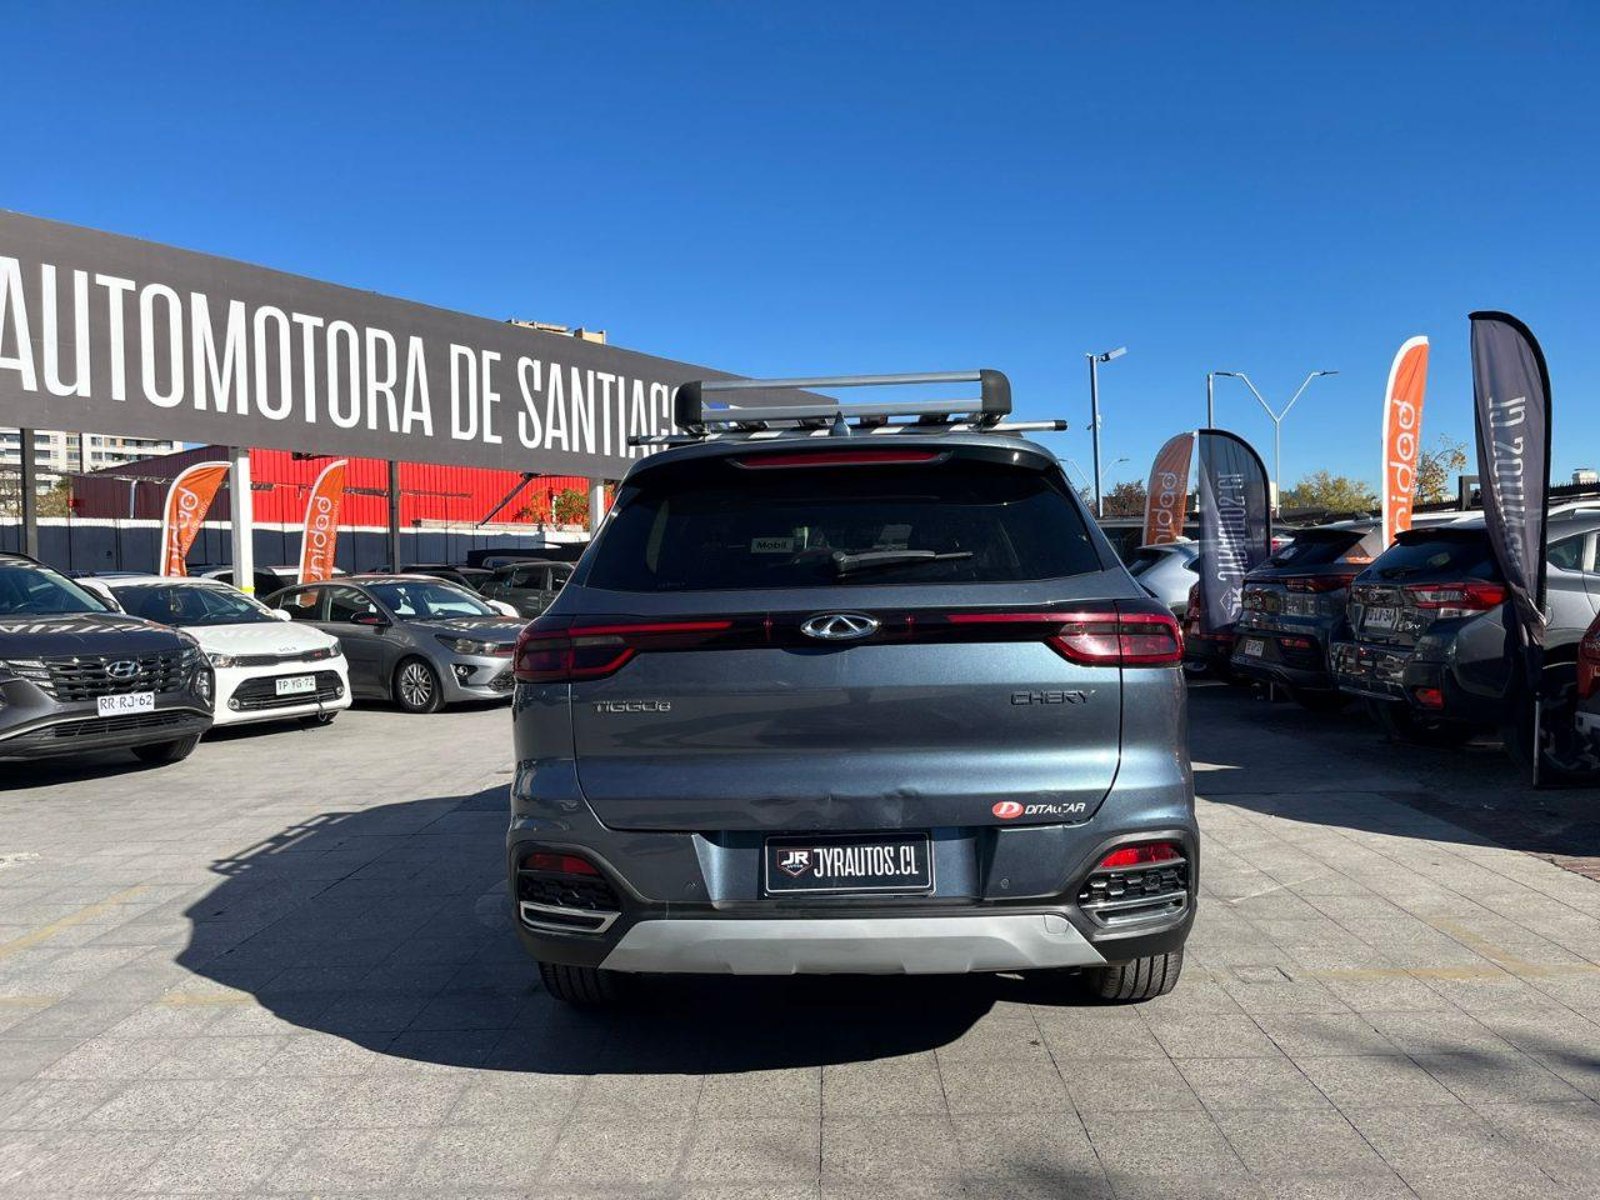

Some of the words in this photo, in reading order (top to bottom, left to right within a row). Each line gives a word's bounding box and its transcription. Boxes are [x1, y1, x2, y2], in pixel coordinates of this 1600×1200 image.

[0, 256, 434, 437] AUTOMOTORA
[450, 343, 502, 445] DE
[757, 541, 787, 550] Mobil
[1010, 689, 1096, 706] CHERY
[813, 845, 919, 878] JYRAUTOS.CL
